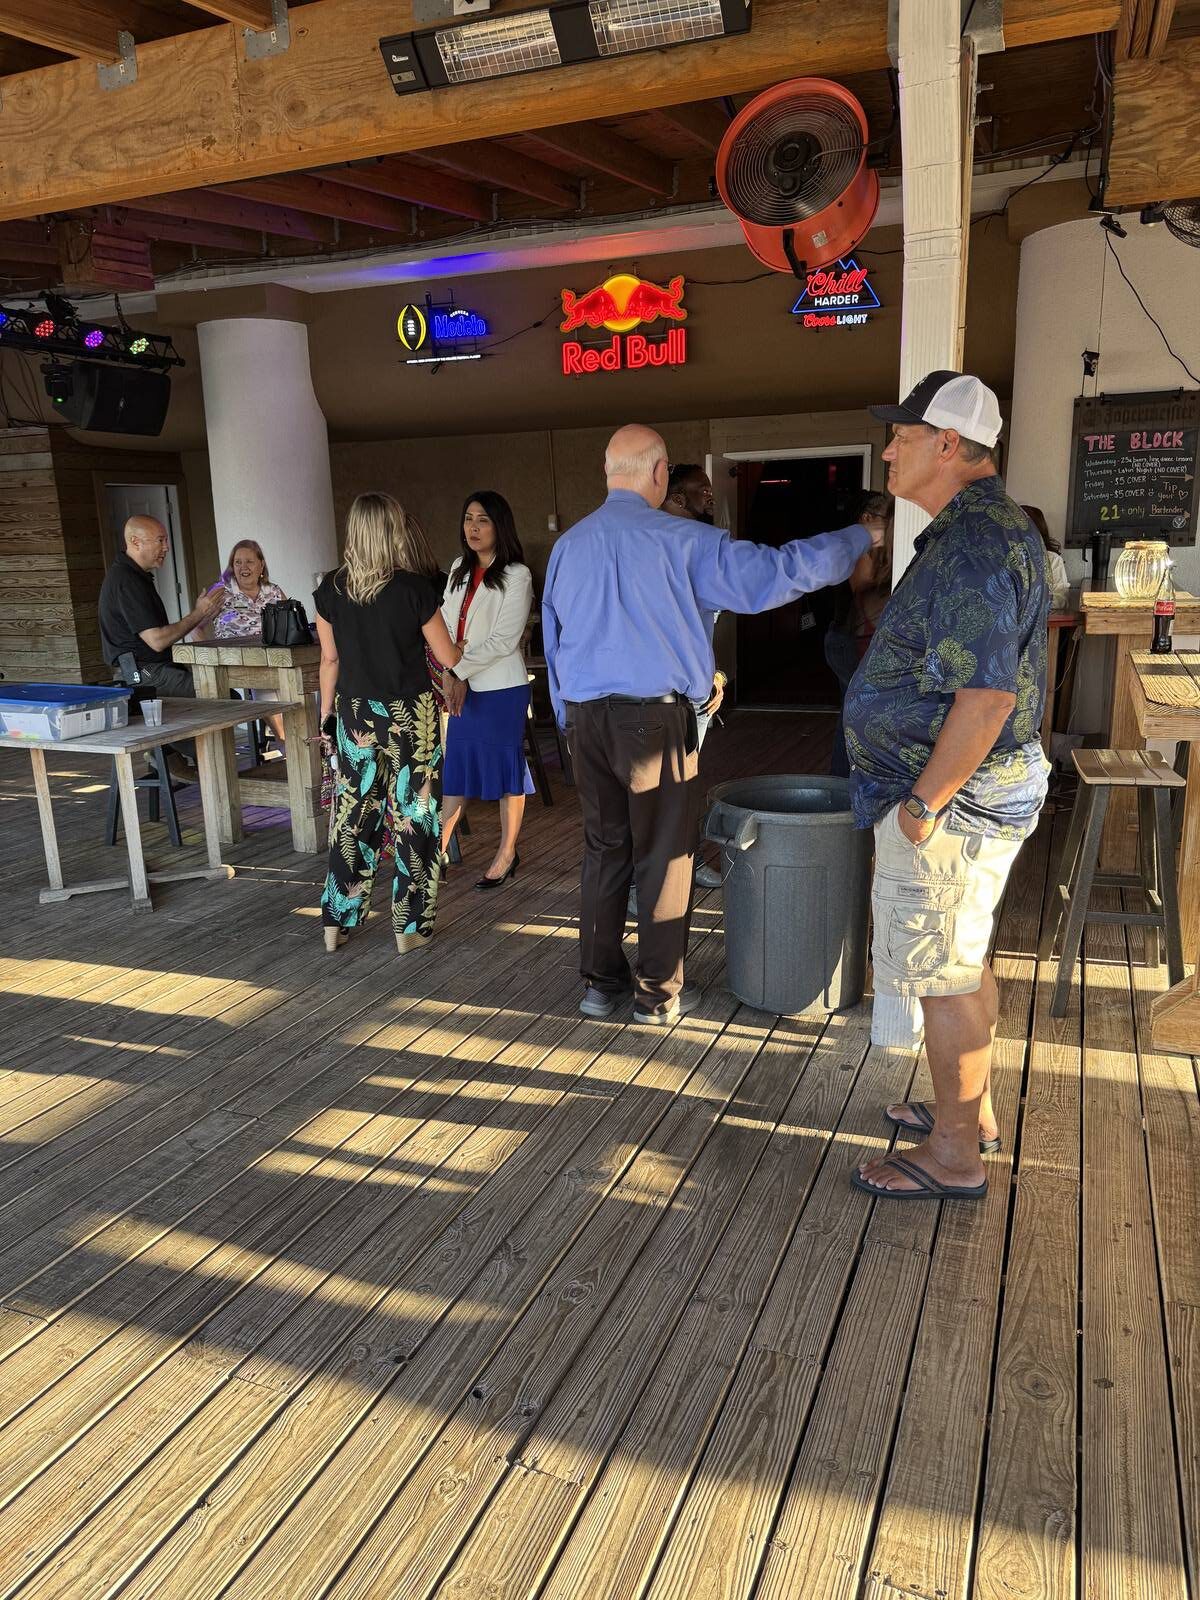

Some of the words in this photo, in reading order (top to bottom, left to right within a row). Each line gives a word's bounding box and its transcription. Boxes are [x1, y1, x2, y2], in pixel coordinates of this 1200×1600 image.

[806, 268, 868, 297] Chill
[814, 294, 859, 307] HARDER
[434, 314, 486, 338] Modelo
[803, 313, 836, 328] Coors
[836, 313, 868, 326] LIGHT
[562, 335, 621, 375] Red
[626, 328, 686, 369] Bull
[1083, 434, 1116, 452] THE
[1129, 431, 1185, 450] BLOCK
[1085, 459, 1116, 468] Wednesday
[1084, 468, 1113, 477] Thursday
[1136, 467, 1153, 475] Night
[1154, 466, 1165, 474] (NO
[1166, 465, 1188, 473] COVER)
[1084, 480, 1105, 488] Friday
[1114, 476, 1125, 486] $5
[1126, 475, 1147, 484] COVER
[1162, 481, 1178, 494] Tip
[1083, 492, 1109, 502] Saturday
[1113, 489, 1124, 499] $5
[1124, 488, 1145, 498] COVER
[1127, 504, 1145, 517] only
[1151, 504, 1184, 515] Bartender
